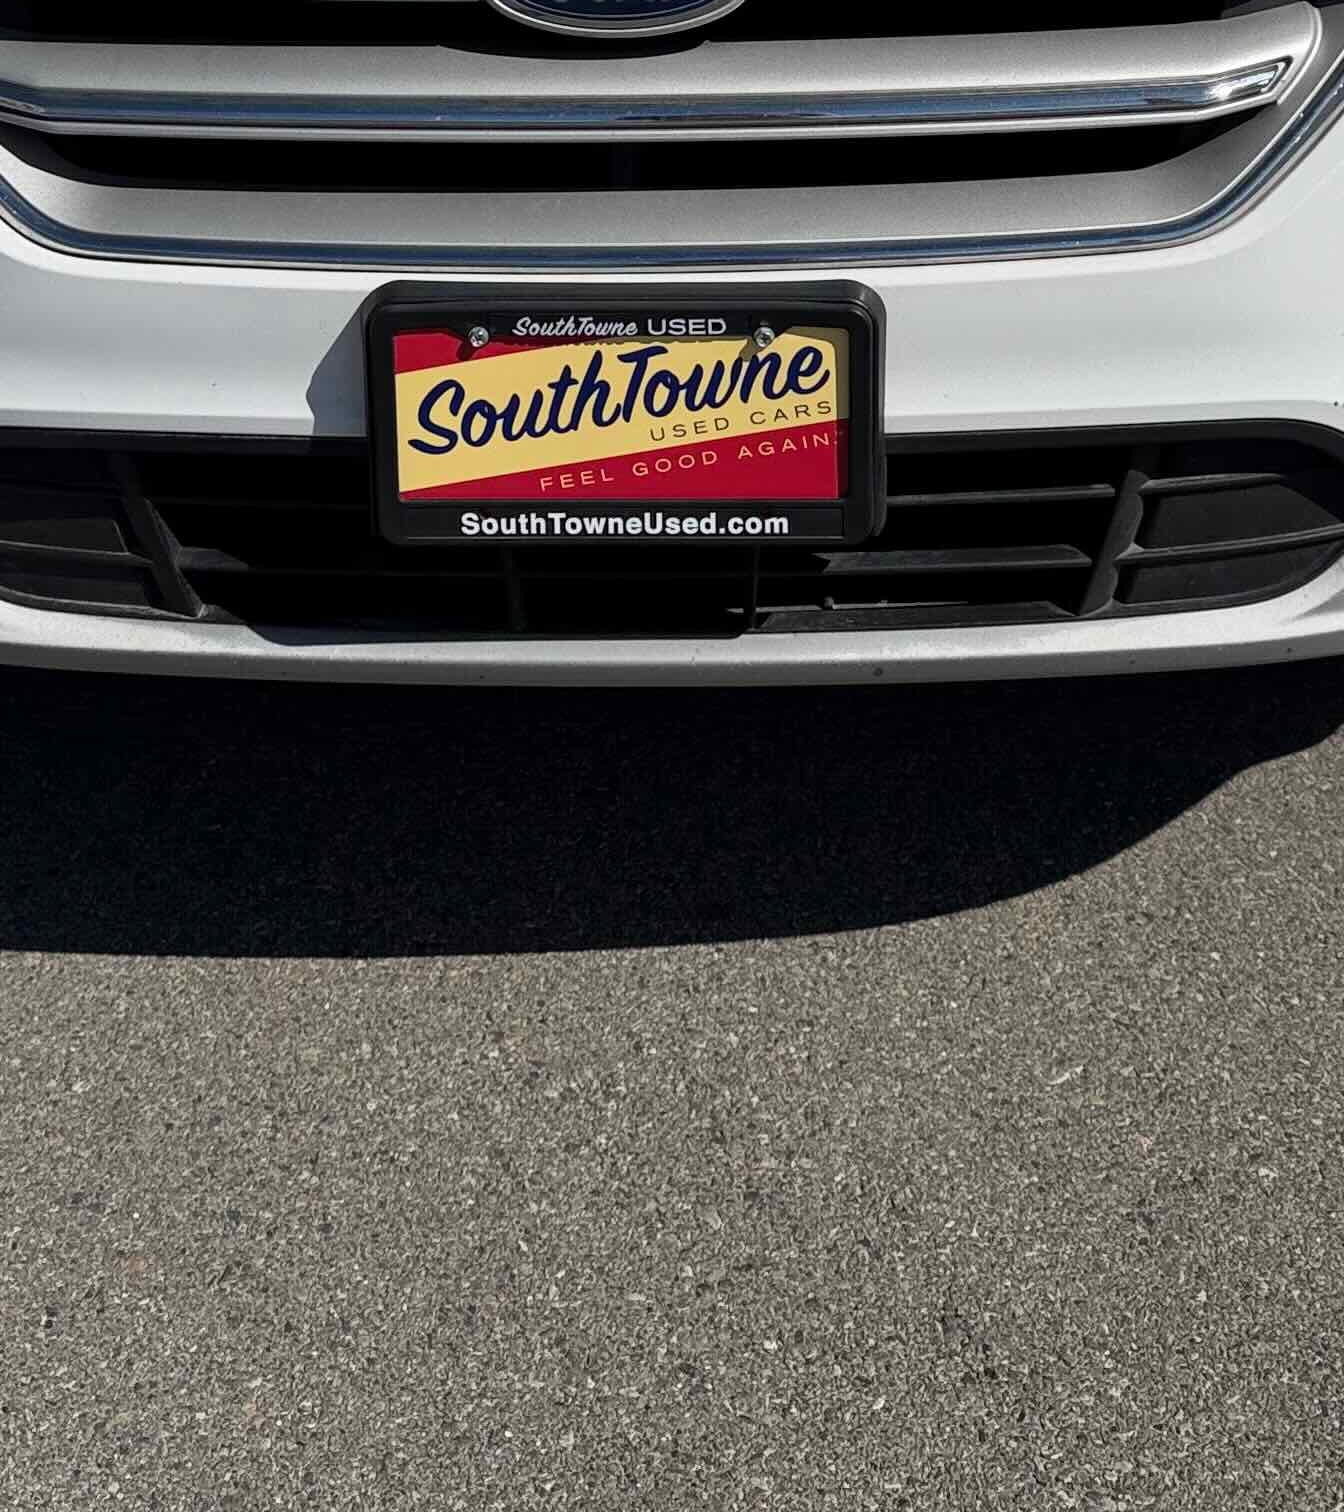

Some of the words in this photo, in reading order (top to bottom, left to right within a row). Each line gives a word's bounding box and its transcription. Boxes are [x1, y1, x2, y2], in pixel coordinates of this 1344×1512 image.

[512, 316, 638, 337] SouthTowne
[647, 318, 727, 336] USED
[407, 345, 831, 455] SouthTowne
[650, 416, 730, 442] USED
[749, 399, 833, 425] CARS
[539, 466, 615, 492] FEEL
[631, 450, 719, 477] GOOD
[460, 512, 790, 536] SouthTowneUsed.com
